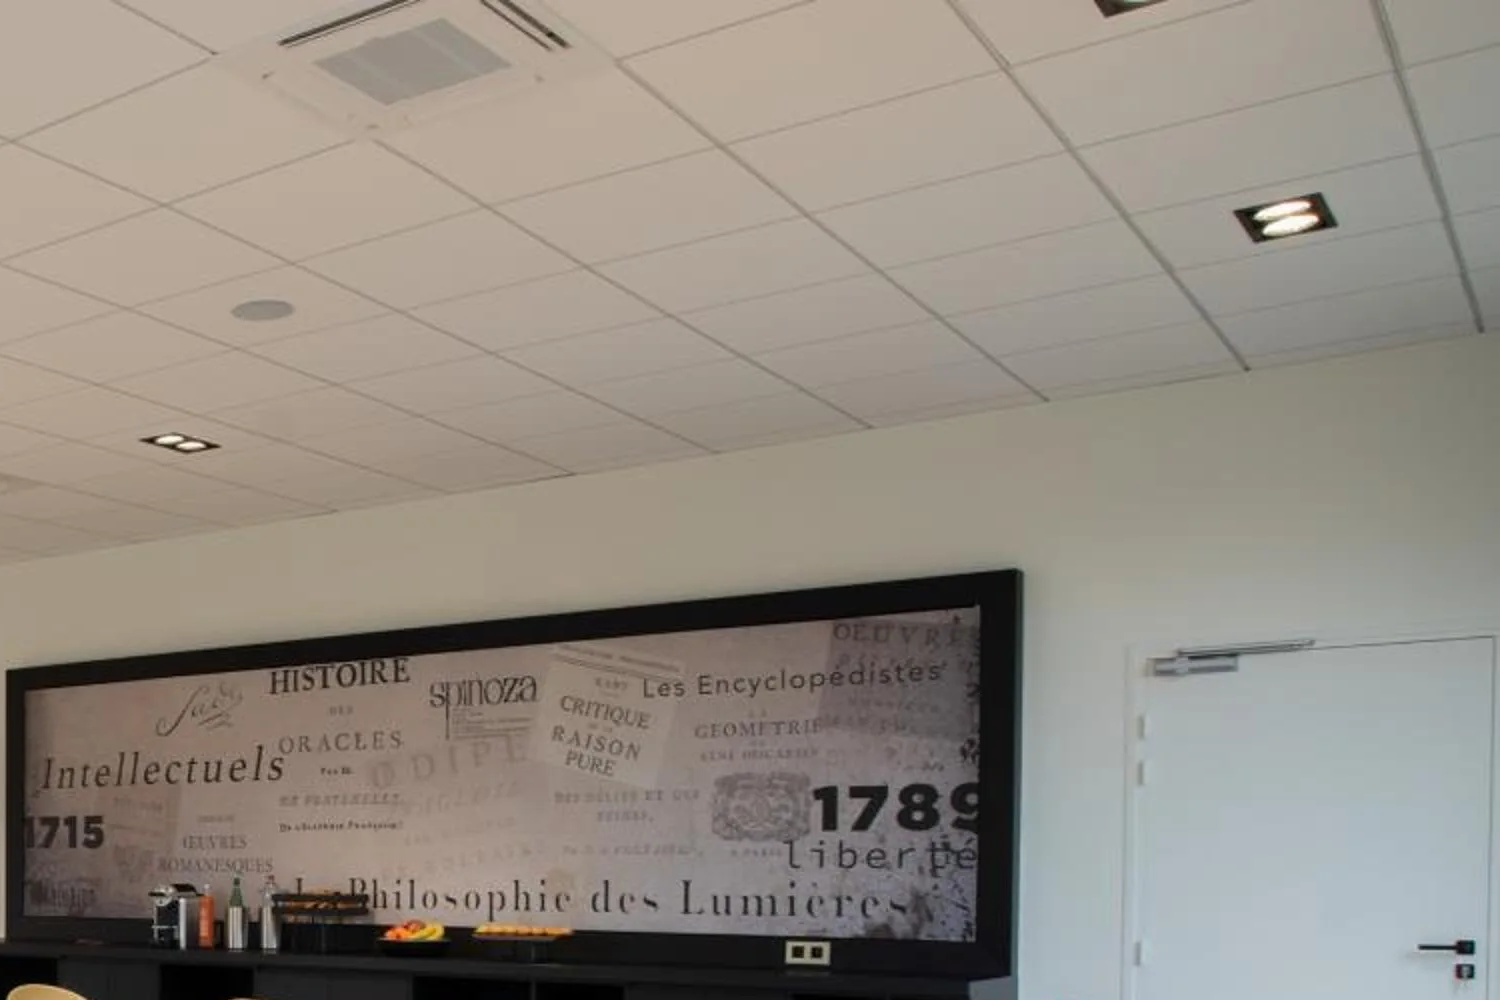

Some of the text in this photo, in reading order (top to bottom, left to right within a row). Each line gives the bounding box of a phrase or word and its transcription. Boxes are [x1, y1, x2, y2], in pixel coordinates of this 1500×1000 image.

[269, 656, 412, 695] HISTOIRE
[642, 677, 686, 698] Les
[429, 674, 538, 741] spinoza
[560, 695, 650, 730] CRITIQUE
[278, 730, 405, 755] ORACLES
[551, 724, 641, 762] RAISON
[40, 744, 285, 791] Intellectuels
[564, 750, 616, 777] PURE
[812, 783, 978, 832] 1789
[24, 816, 104, 849] 1715
[349, 877, 572, 922] Philosophie
[590, 878, 659, 914] des
[679, 879, 907, 918] Lumières
